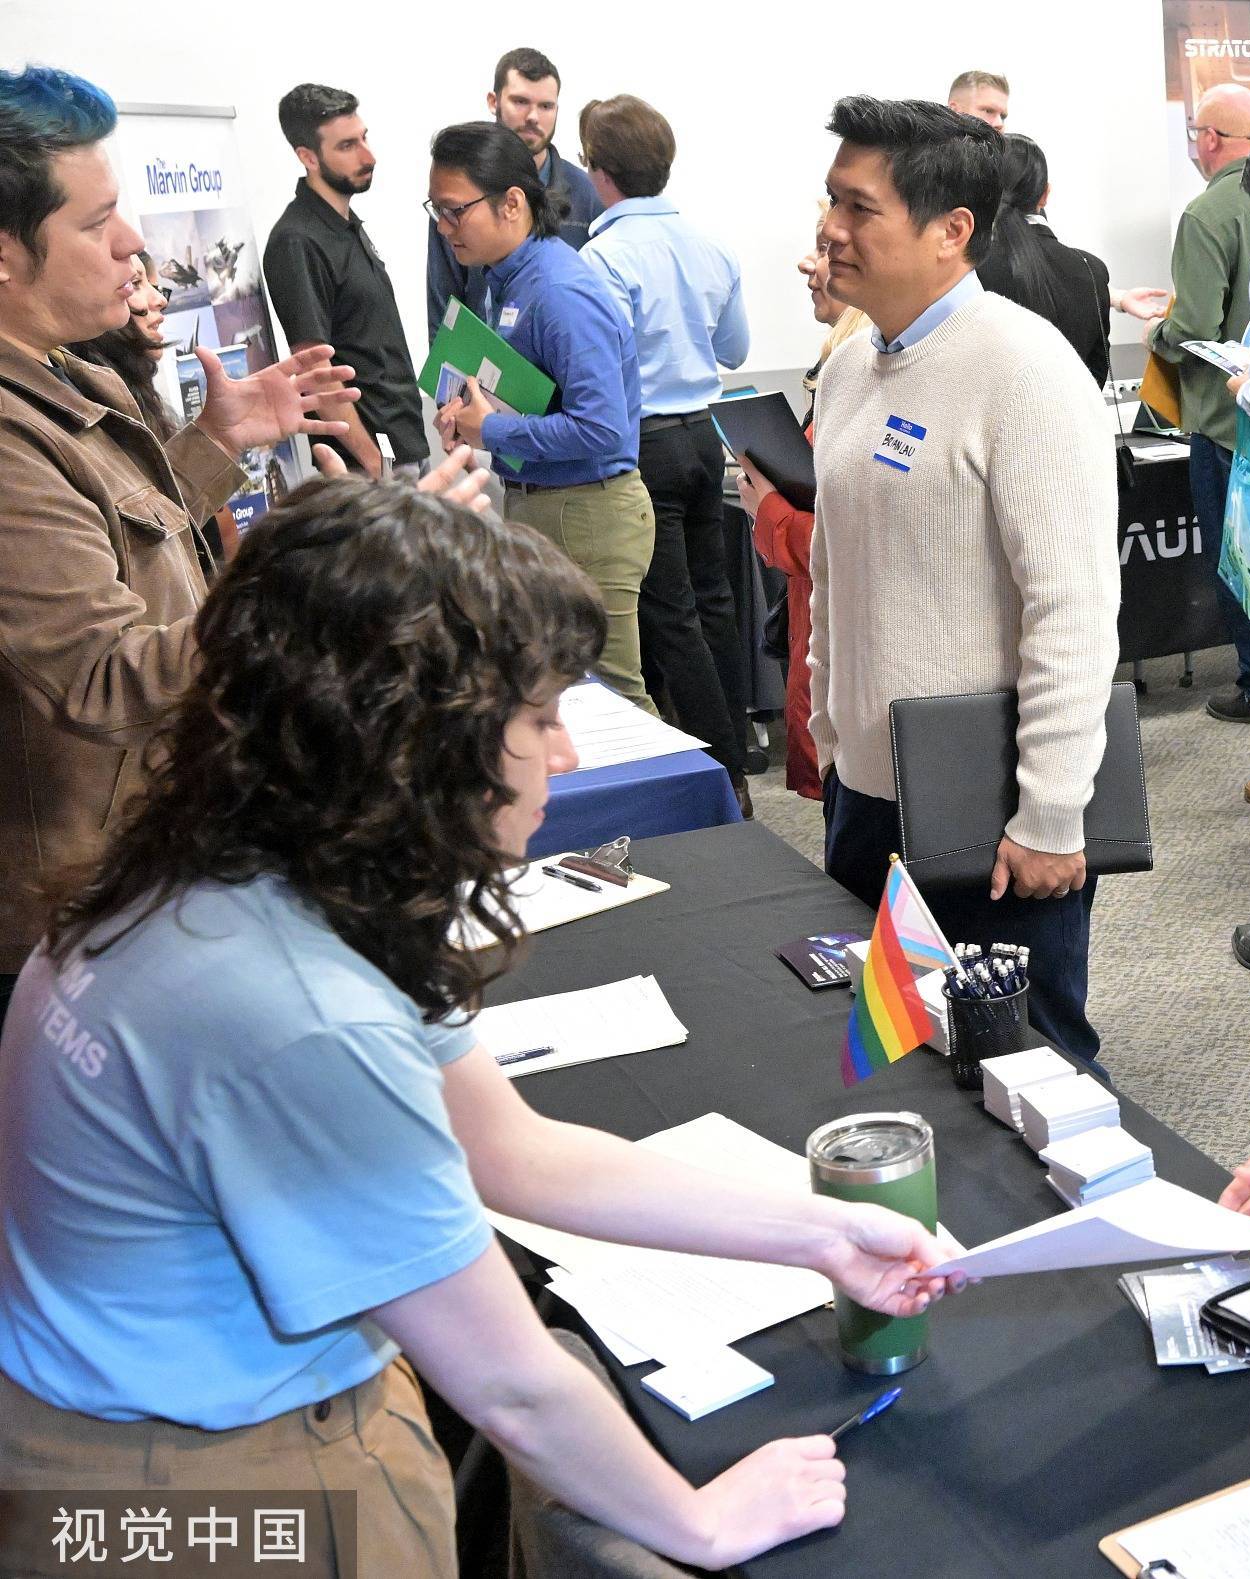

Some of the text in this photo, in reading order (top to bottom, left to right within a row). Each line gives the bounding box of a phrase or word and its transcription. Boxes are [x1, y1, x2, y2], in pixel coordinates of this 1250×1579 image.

[155, 157, 166, 169] The
[146, 162, 223, 200] Marvin Group
[235, 506, 254, 520] Group
